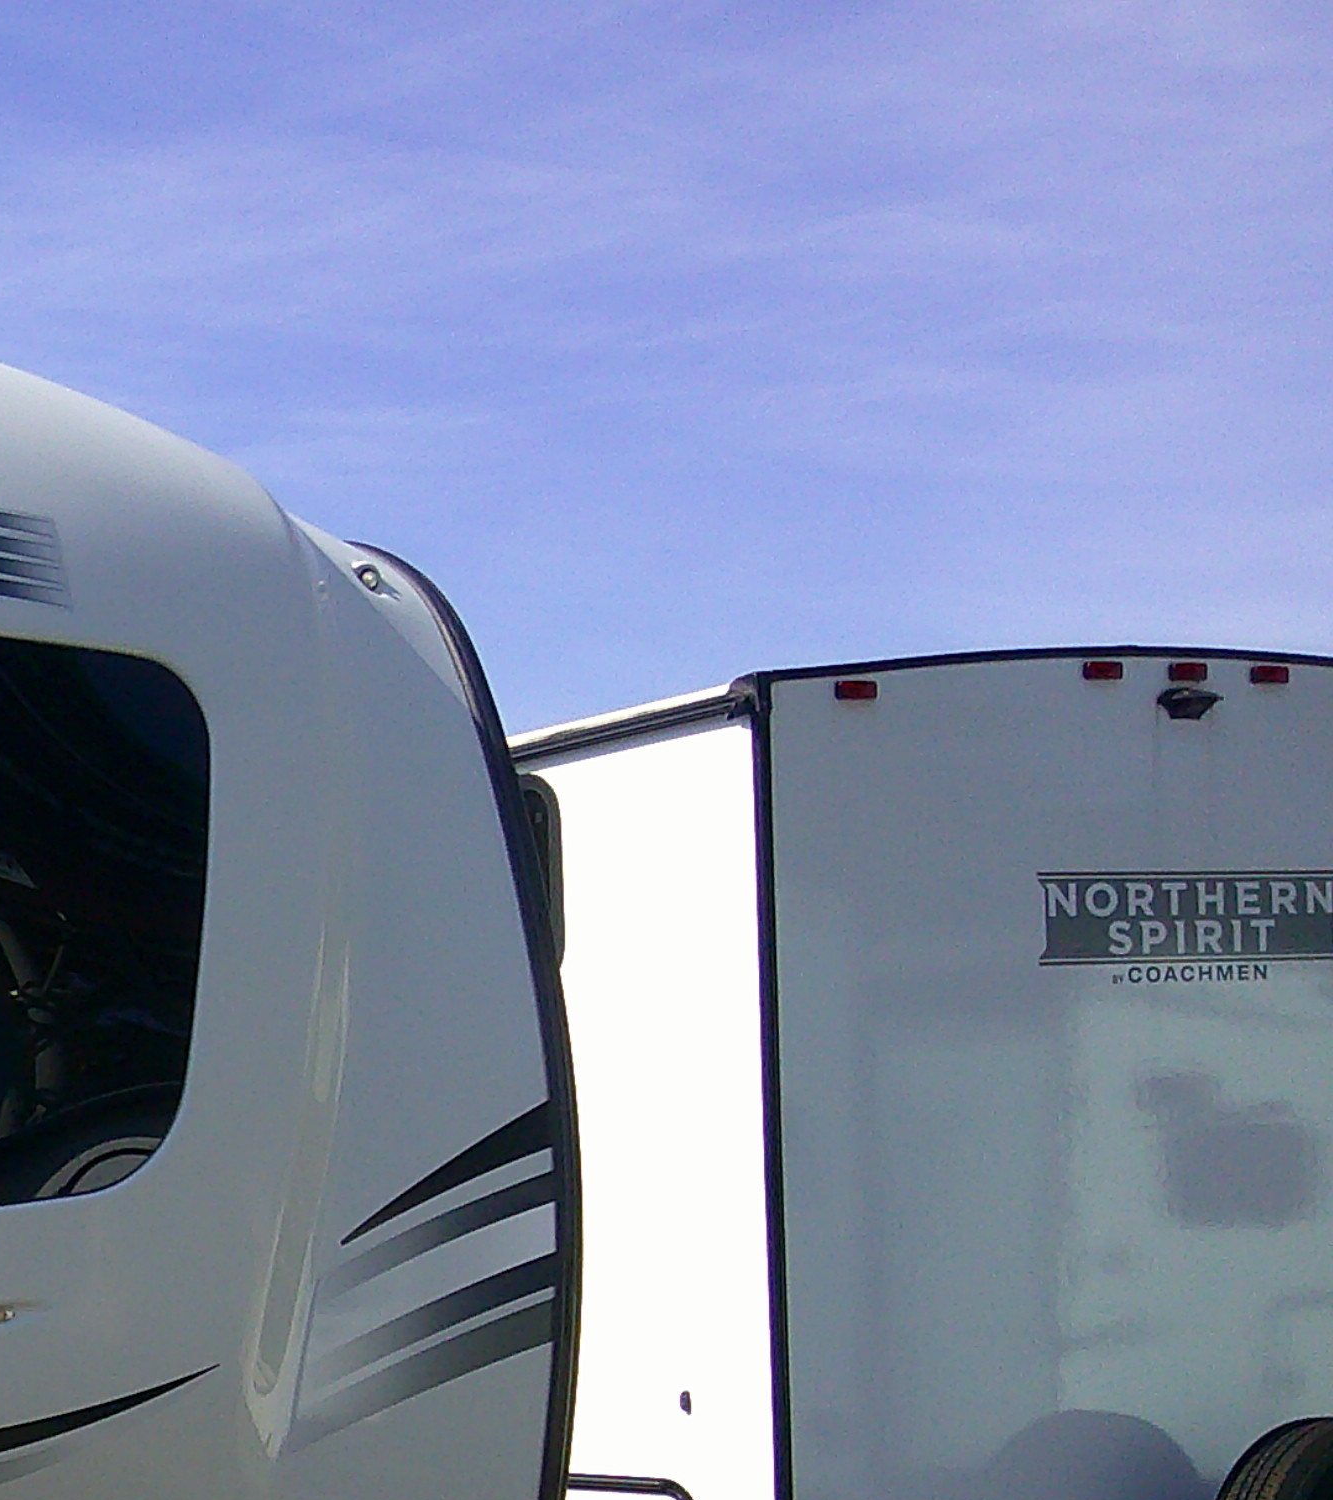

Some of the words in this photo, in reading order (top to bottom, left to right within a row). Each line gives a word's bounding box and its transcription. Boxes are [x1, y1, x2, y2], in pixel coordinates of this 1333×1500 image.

[1045, 880, 1333, 918] NORTHERN
[1107, 918, 1276, 955] SPIRIT
[1127, 964, 1268, 984] COACHMEN
